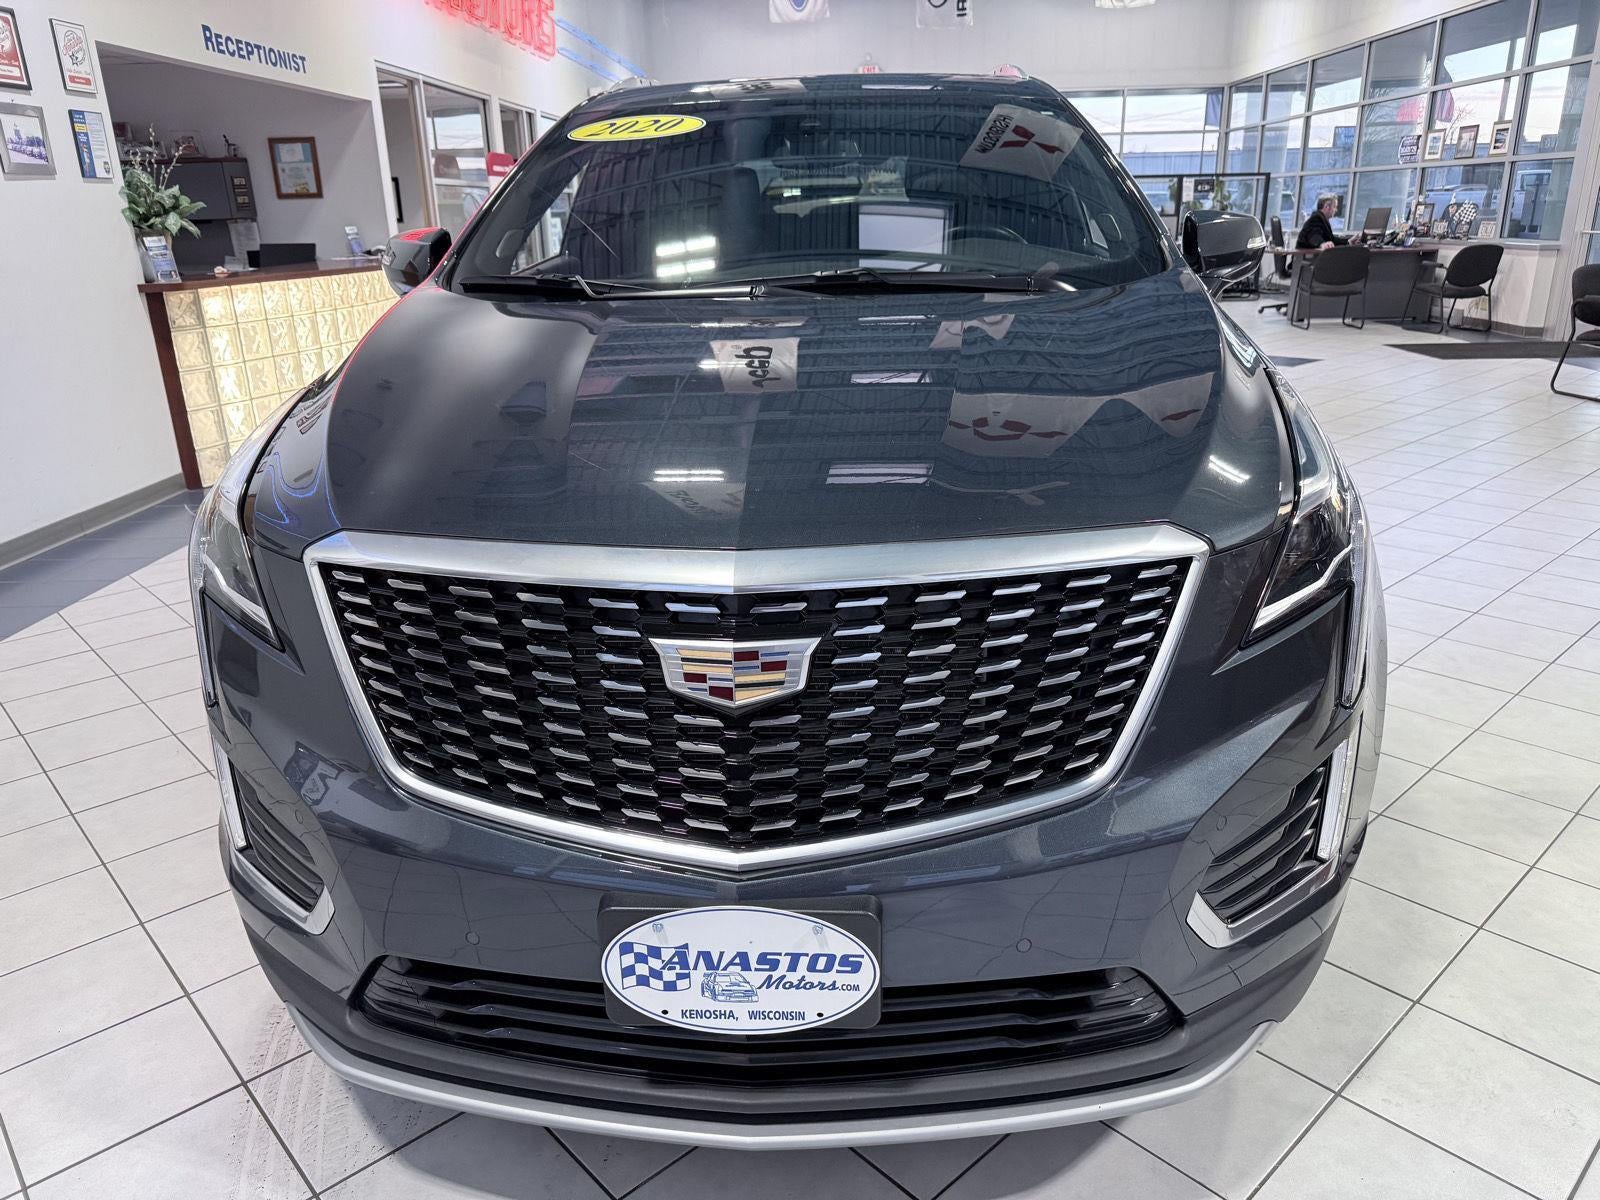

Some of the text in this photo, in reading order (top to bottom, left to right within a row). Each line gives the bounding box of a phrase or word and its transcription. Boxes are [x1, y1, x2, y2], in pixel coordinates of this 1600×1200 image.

[201, 24, 306, 74] RECEPTIONIST
[583, 118, 685, 137] 2020
[660, 949, 865, 974] ANASTOS
[681, 1009, 806, 1022] KENOSHA, WISCONSIN
